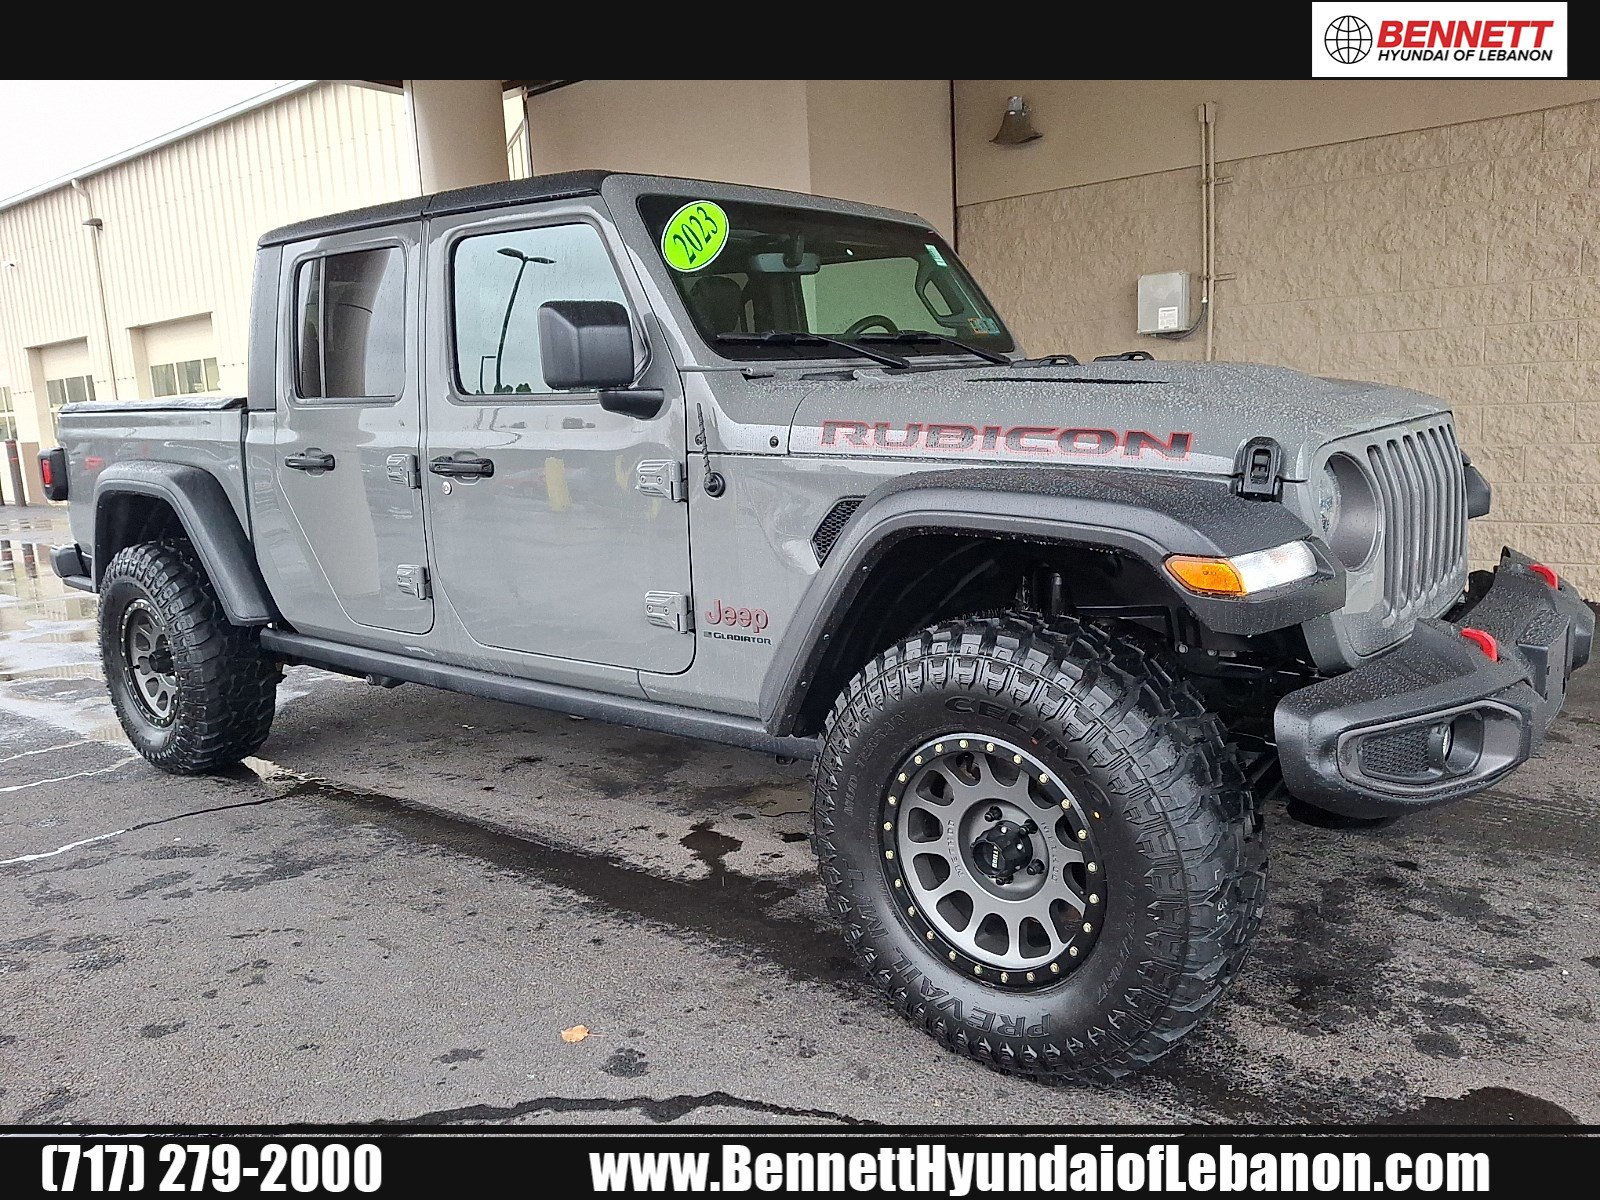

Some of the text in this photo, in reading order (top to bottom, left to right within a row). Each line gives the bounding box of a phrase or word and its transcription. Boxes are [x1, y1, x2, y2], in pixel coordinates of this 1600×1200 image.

[673, 206, 718, 264] 2023
[821, 421, 1192, 461] RUBICON
[705, 599, 769, 633] Jeep
[713, 632, 772, 645] GLADIATOR
[890, 946, 1051, 1038] PREVAIL
